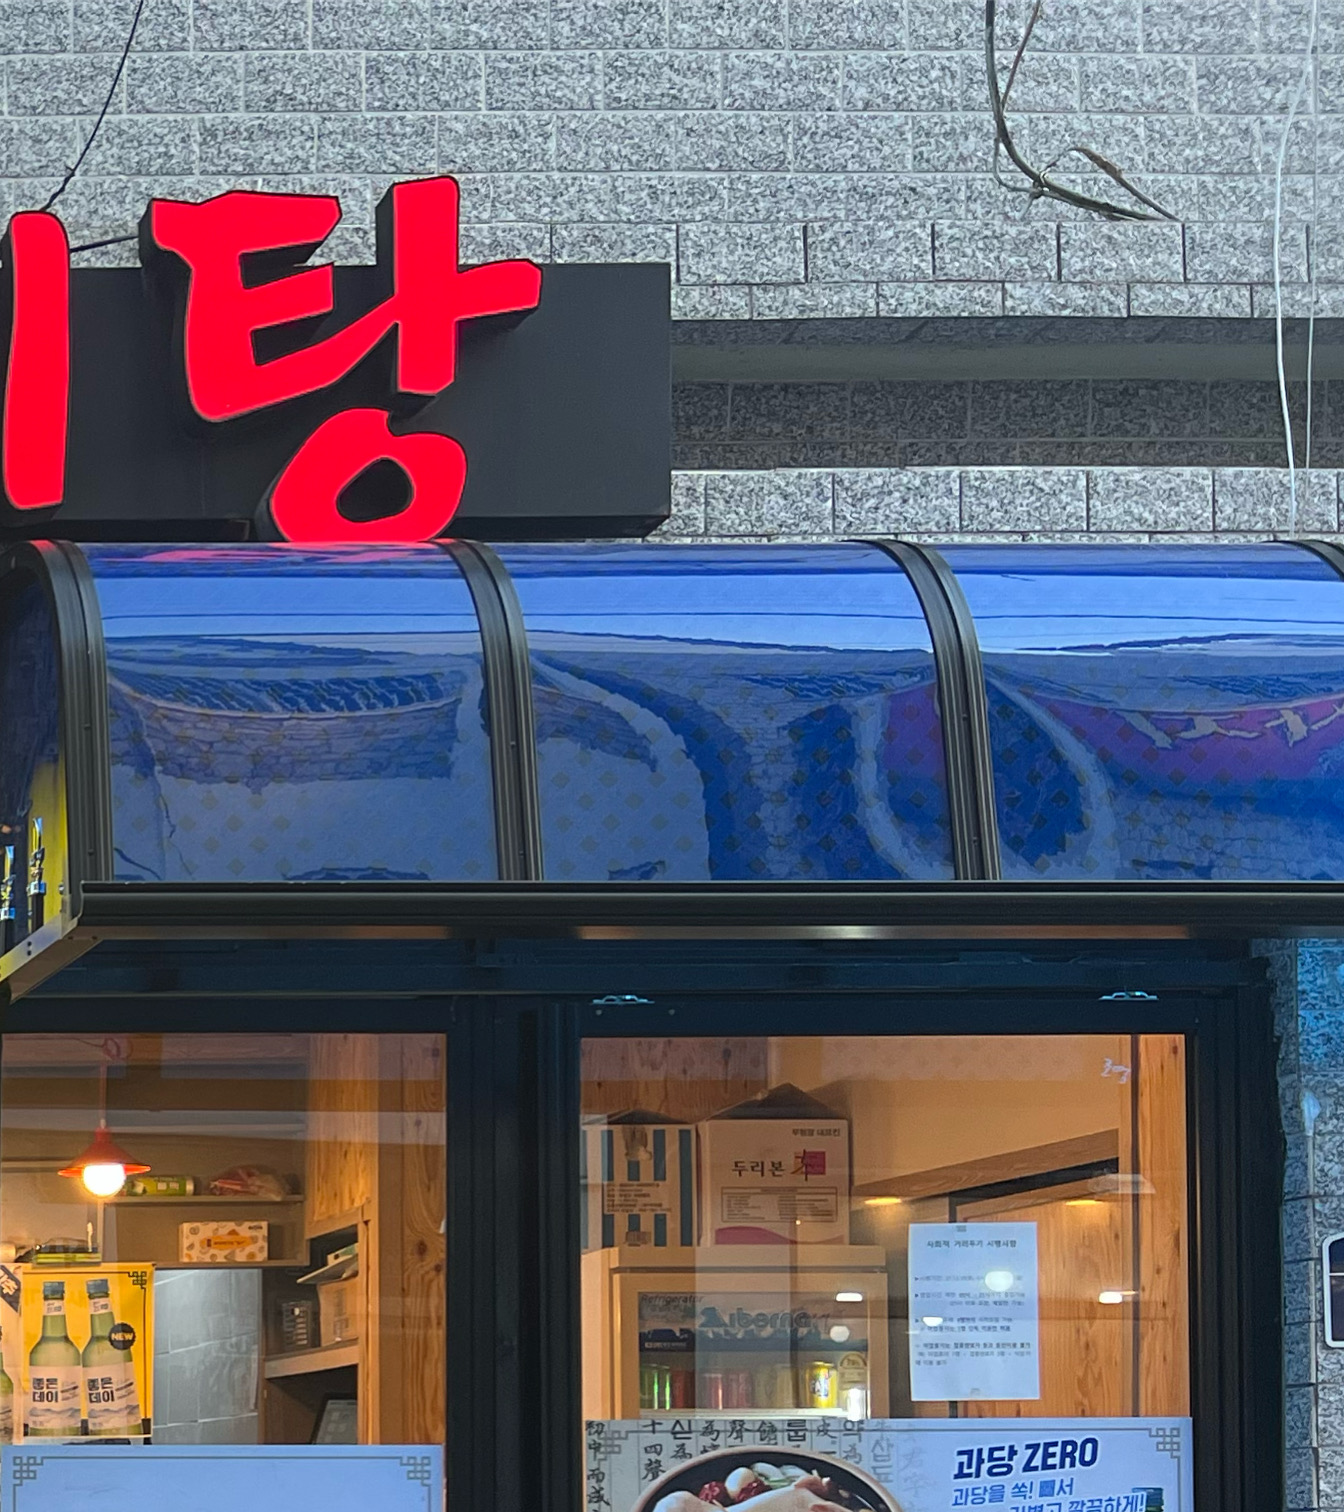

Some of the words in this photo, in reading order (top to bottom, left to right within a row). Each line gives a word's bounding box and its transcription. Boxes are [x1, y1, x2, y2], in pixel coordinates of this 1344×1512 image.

[111, 1332, 134, 1341] NEW
[32, 1391, 59, 1403] 데이
[88, 1390, 115, 1404] 데이
[953, 1444, 1018, 1480] 과당
[1021, 1437, 1099, 1473] ZERO
[951, 1484, 1006, 1507] 과당을
